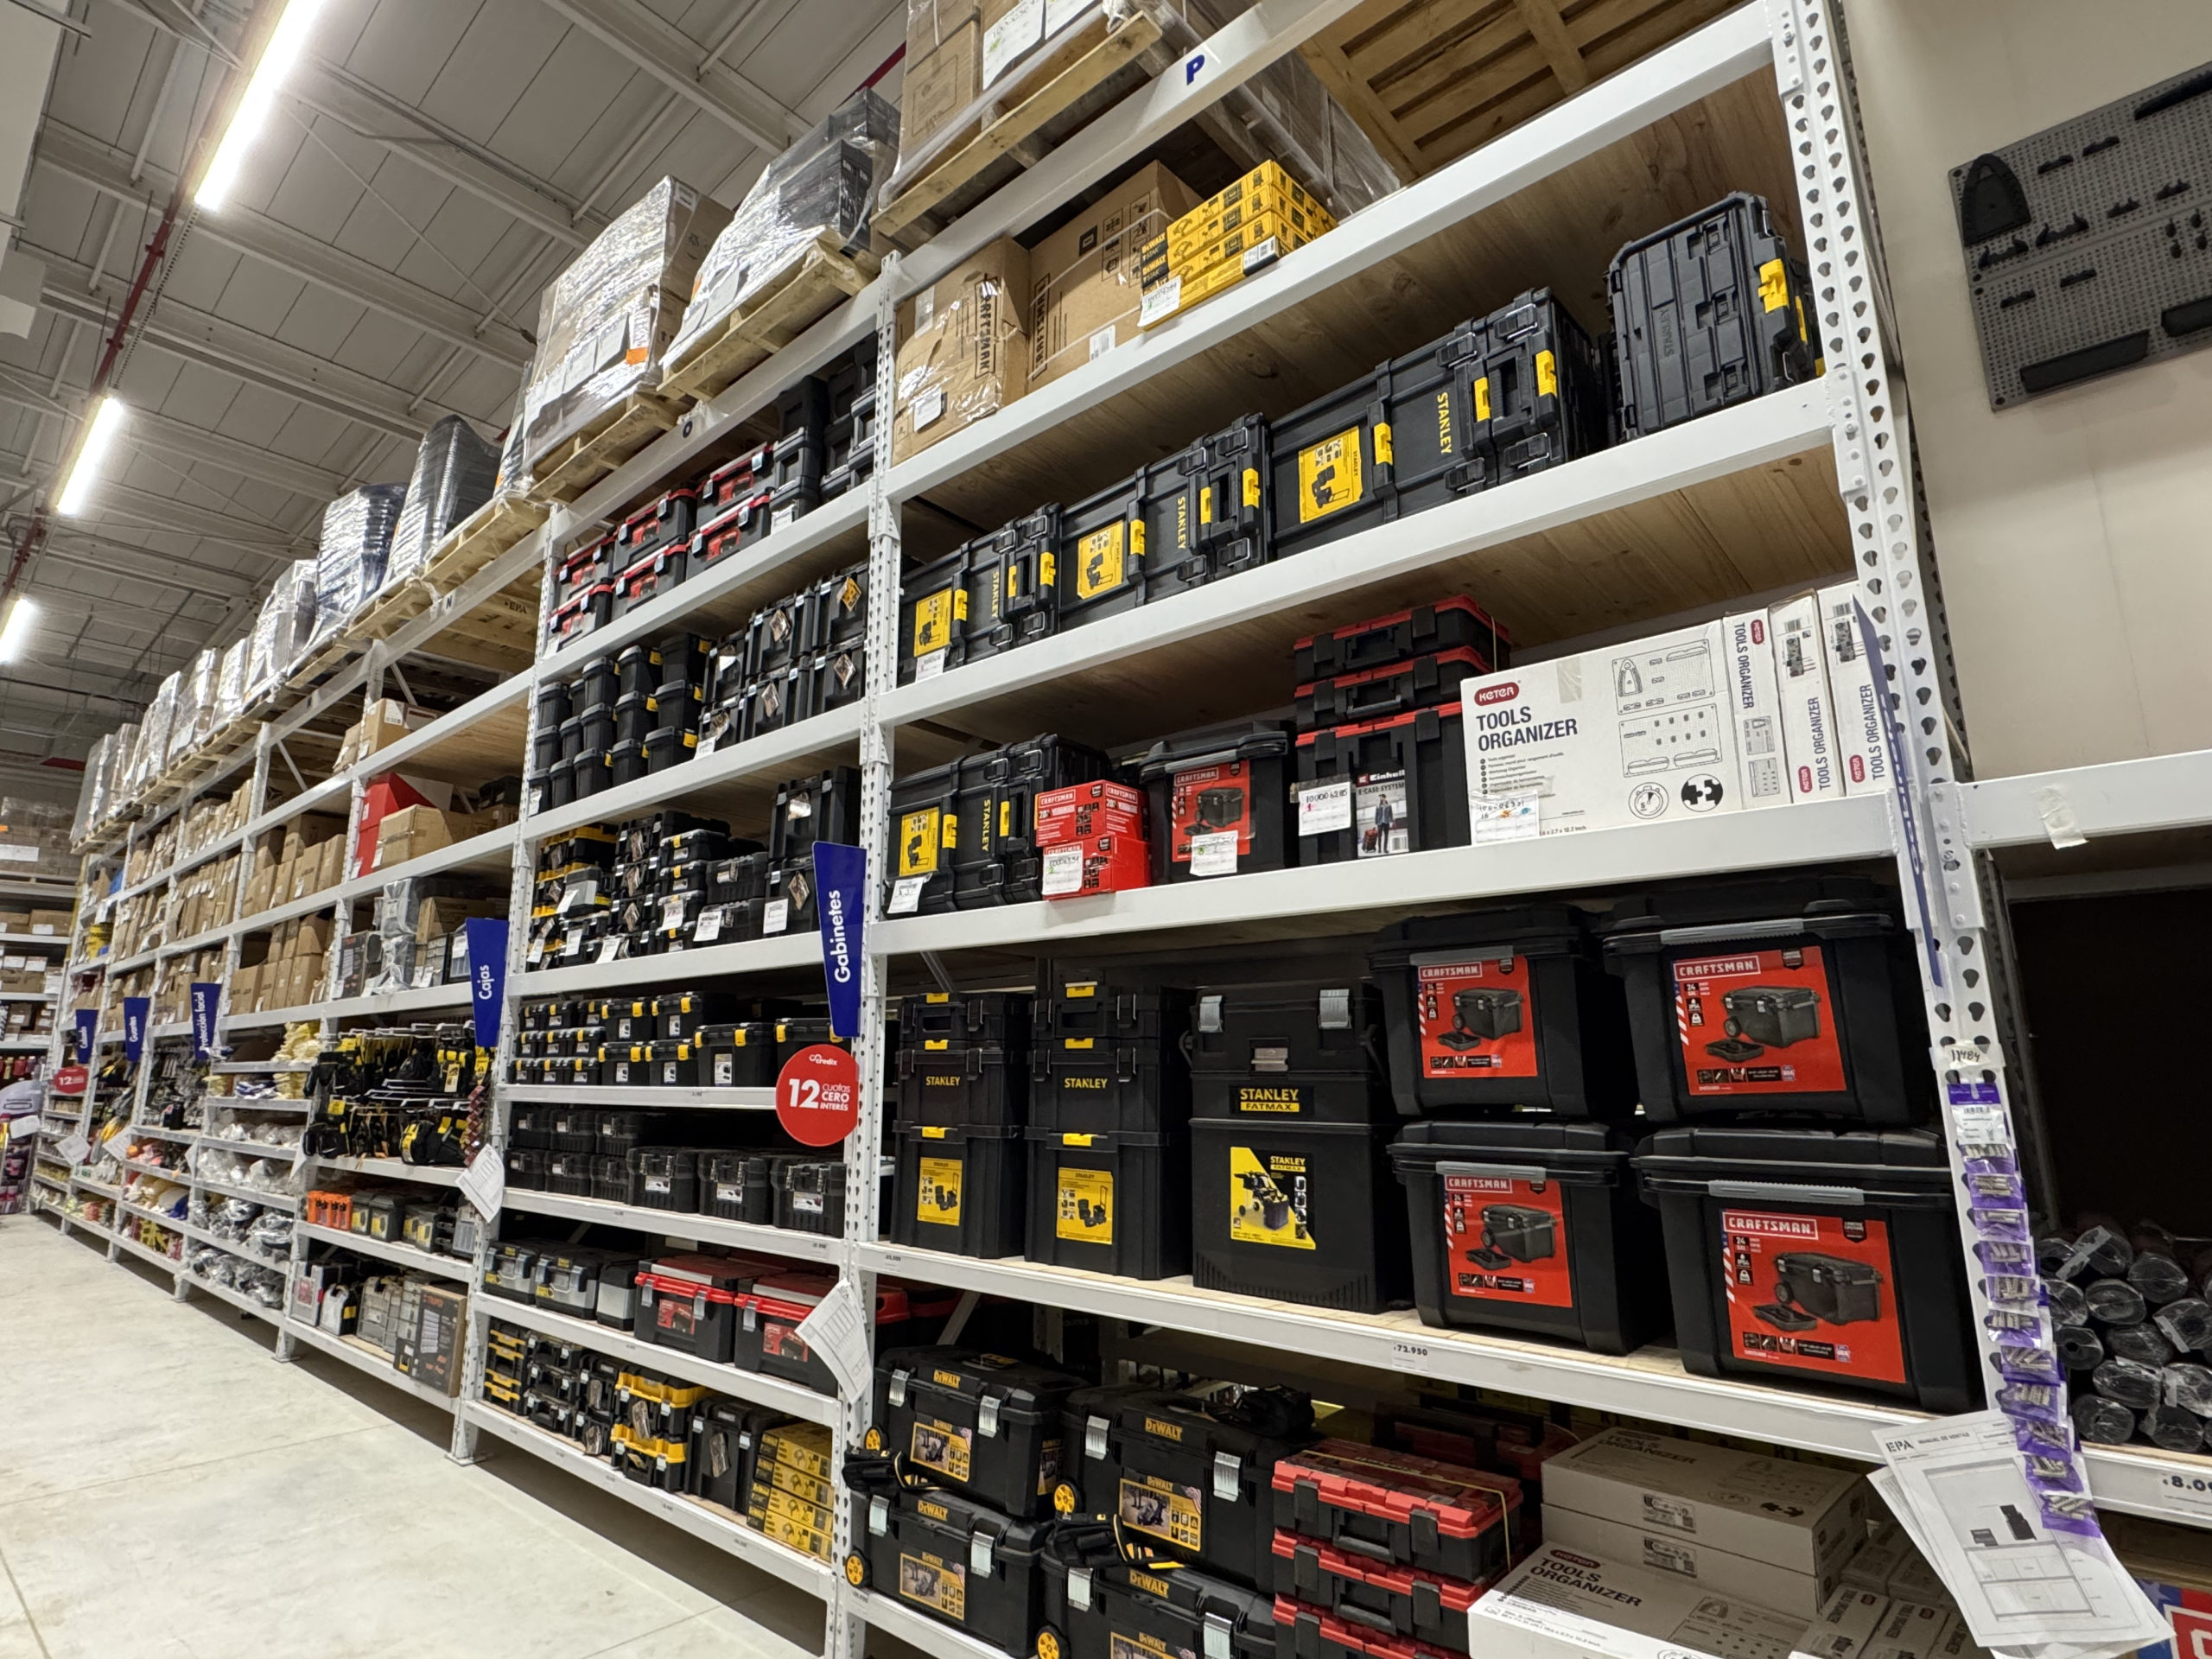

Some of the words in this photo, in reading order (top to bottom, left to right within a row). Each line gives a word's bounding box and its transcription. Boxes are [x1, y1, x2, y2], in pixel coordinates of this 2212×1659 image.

[1186, 54, 1205, 85] P
[1438, 391, 1452, 454] STANLEY
[1178, 496, 1186, 550] STANLEY
[1735, 622, 1748, 652] TOOLS
[1738, 653, 1754, 709] ORGANIZER
[1476, 706, 1532, 731] TOOLS
[1808, 697, 1827, 755] ORGANIZER
[1859, 684, 1880, 743] ORGANIZER
[1478, 719, 1578, 751] ORGANIZER
[1815, 757, 1831, 791] TOOLS
[1869, 746, 1885, 781] TOOLS
[1177, 771, 1217, 783] CRAFTSMAN
[1040, 794, 1073, 805] CRAFTSMAN
[1108, 787, 1136, 800] CRAFTSMAN
[982, 799, 991, 851] STANLEY
[830, 890, 851, 983] Gabinetes
[1422, 965, 1478, 978] CRAFTSMAN
[1680, 960, 1754, 976] CRAFTSMAN
[477, 964, 495, 1000] Cajas
[59, 1077, 73, 1085] 12
[789, 1078, 821, 1109] 12
[822, 1084, 850, 1093] cuotas
[925, 1077, 961, 1086] STANLEY
[1065, 1078, 1108, 1089] STANLEY
[821, 1091, 849, 1103] CERO
[1240, 1088, 1299, 1102] STANLEY
[1245, 1103, 1293, 1111] FATMAX
[1270, 1155, 1306, 1166] STANLEY
[1449, 1178, 1508, 1189] CRAFTSMAN
[1729, 1217, 1810, 1234] CRAFTSMAN
[1885, 1440, 1915, 1453] EPA
[1541, 1557, 1602, 1582] TOOLS
[1530, 1566, 1643, 1607] ORGANIZER
